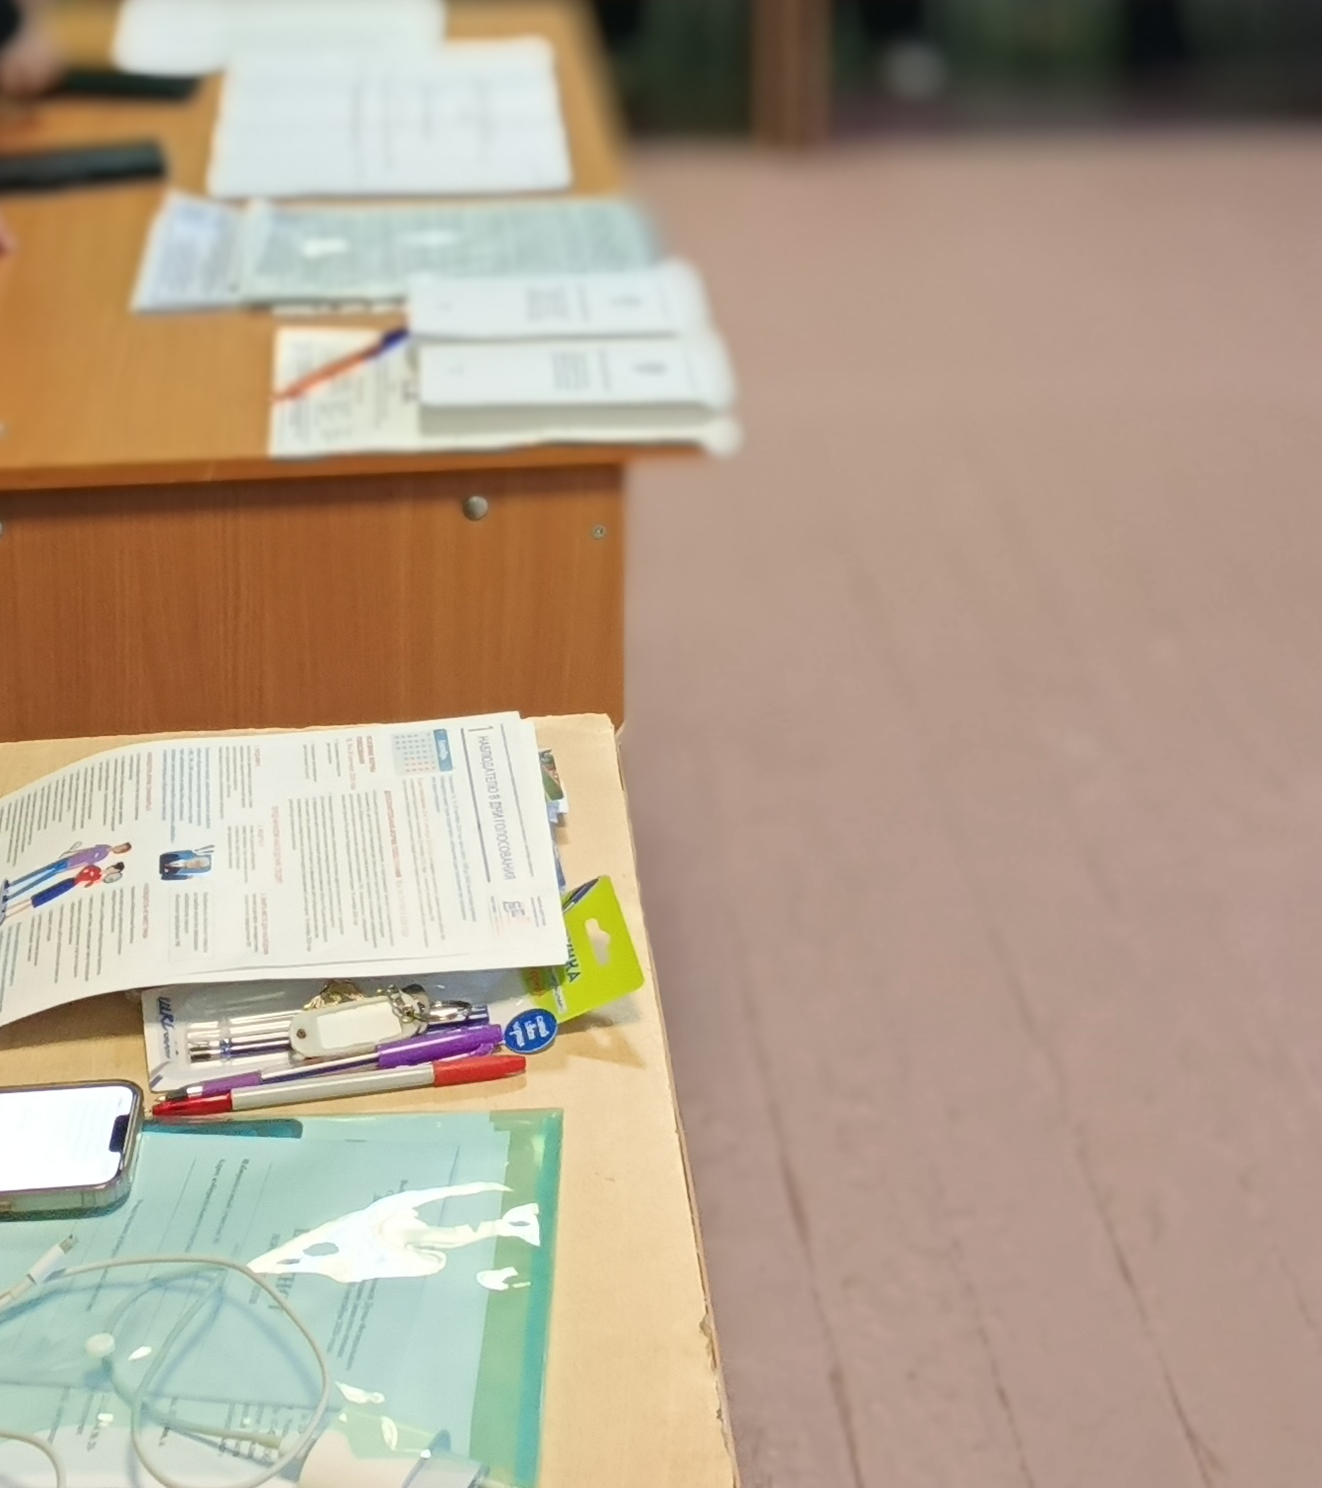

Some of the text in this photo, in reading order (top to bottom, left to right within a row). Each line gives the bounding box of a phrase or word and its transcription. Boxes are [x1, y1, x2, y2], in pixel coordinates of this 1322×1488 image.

[478, 735, 504, 794] НАБЛЮДАТЕЛЮ
[489, 801, 505, 819] ДНИ
[494, 819, 516, 881] ГОЛОСОВАНИЯ
